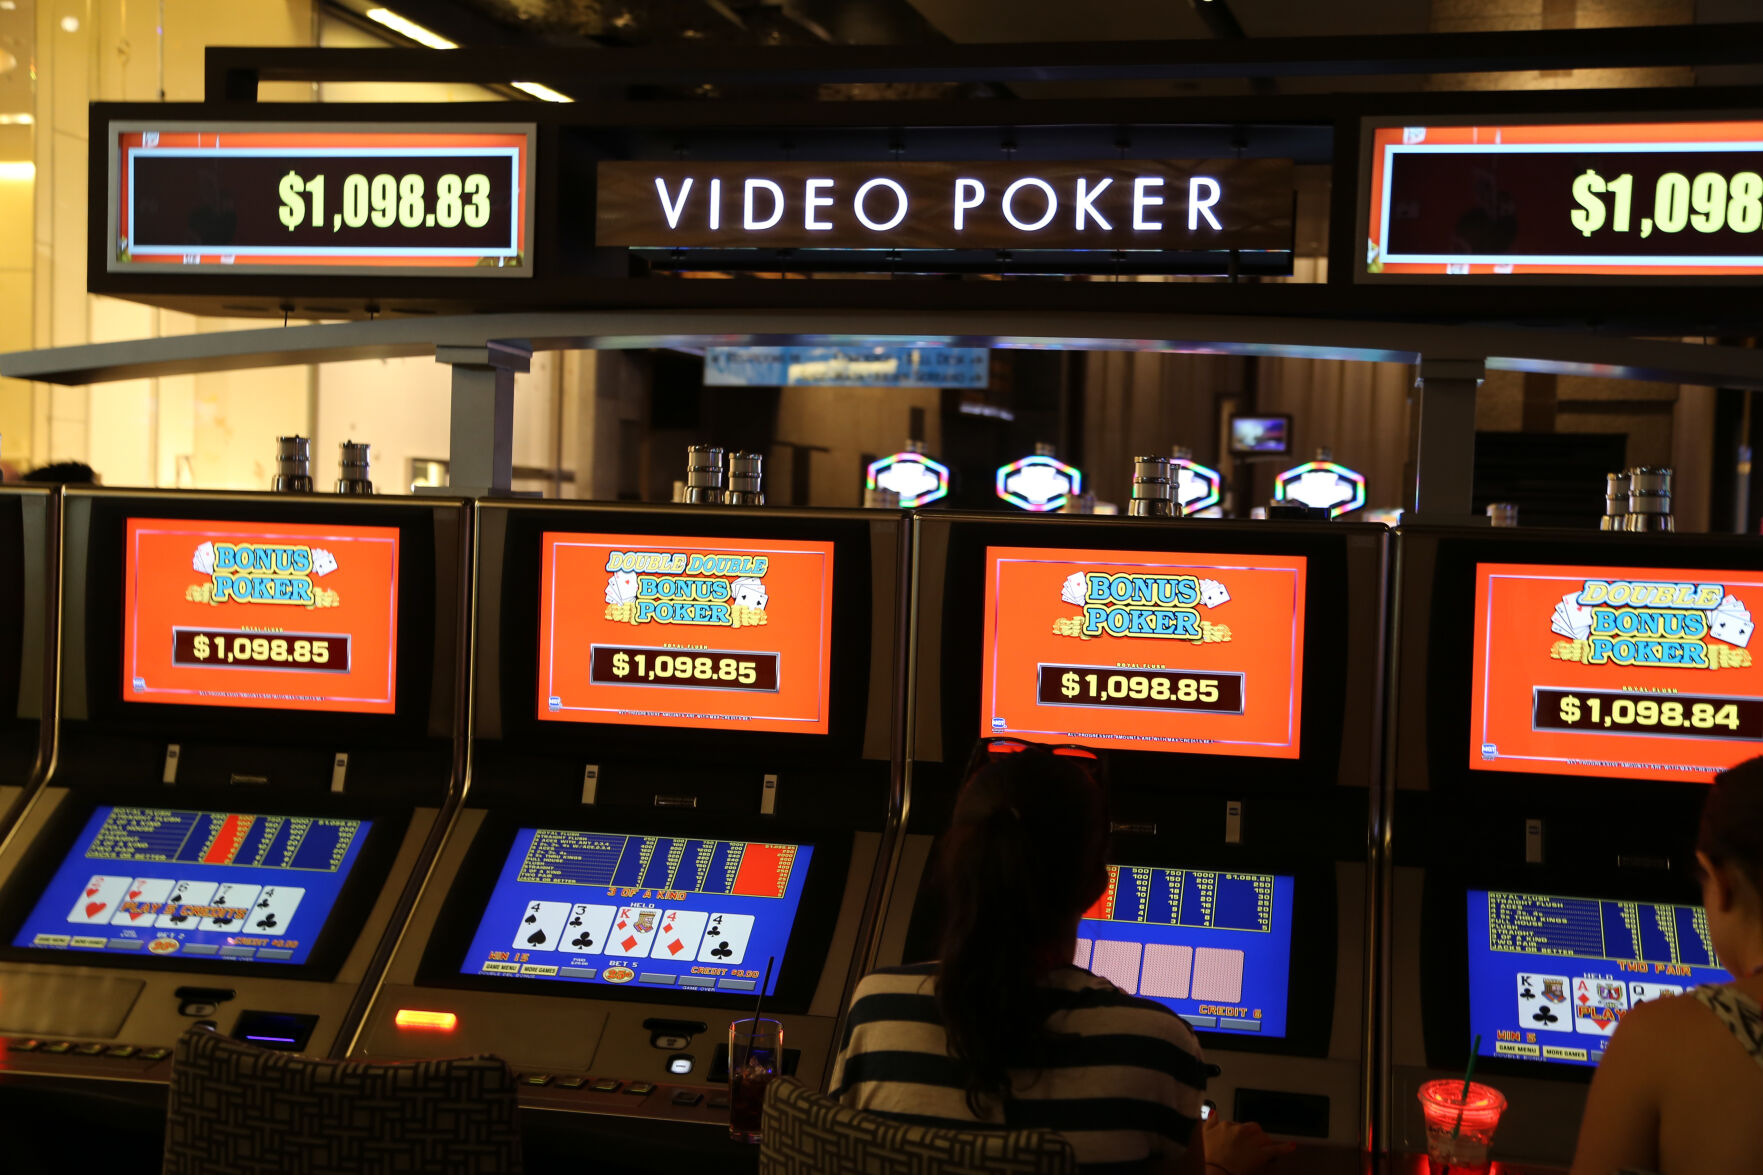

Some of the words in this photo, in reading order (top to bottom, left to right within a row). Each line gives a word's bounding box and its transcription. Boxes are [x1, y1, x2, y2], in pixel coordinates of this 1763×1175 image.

[278, 170, 491, 232] $1,098.83
[654, 177, 908, 231] VIDEO
[953, 177, 1223, 231] POKER
[215, 545, 312, 573] BONUS
[607, 552, 685, 572] DOUBLE
[688, 556, 768, 575] DOUBLE
[213, 575, 312, 601] POKER
[639, 577, 730, 600] BONUS
[1088, 575, 1198, 604] BONUS
[1580, 582, 1723, 606] DOUBLE
[637, 601, 732, 624] POKER
[1086, 607, 1200, 637] POKER
[1594, 610, 1705, 636] BONUS
[193, 633, 329, 664] $1,098.85
[1591, 638, 1706, 664] POKER
[612, 651, 757, 685] $1,098.85
[1061, 671, 1220, 704] $1,098.85
[1559, 694, 1740, 731] $1,098.84
[606, 887, 616, 896] 3
[621, 888, 639, 897] OF
[642, 890, 651, 898] A
[656, 891, 687, 901] KIND
[120, 901, 161, 913] PLAY
[181, 905, 248, 919] CREDITS
[530, 902, 541, 912] 4
[575, 905, 587, 915] 3
[620, 908, 632, 919] K
[666, 912, 677, 922] 4
[713, 915, 723, 925] 4
[488, 951, 509, 961] WIN
[513, 953, 530, 962] 15
[691, 966, 728, 976] CREDIT
[1617, 960, 1649, 973] TWO
[1655, 963, 1692, 977] PAIR
[1521, 975, 1532, 987] K
[1578, 980, 1588, 991] A
[1633, 985, 1645, 997] Q
[1199, 1004, 1248, 1018] CREDIT
[1577, 1005, 1627, 1021] PLAY
[1497, 1030, 1520, 1042] WIN
[1517, 1046, 1537, 1054] MENU
[1564, 1050, 1585, 1058] GAMES
